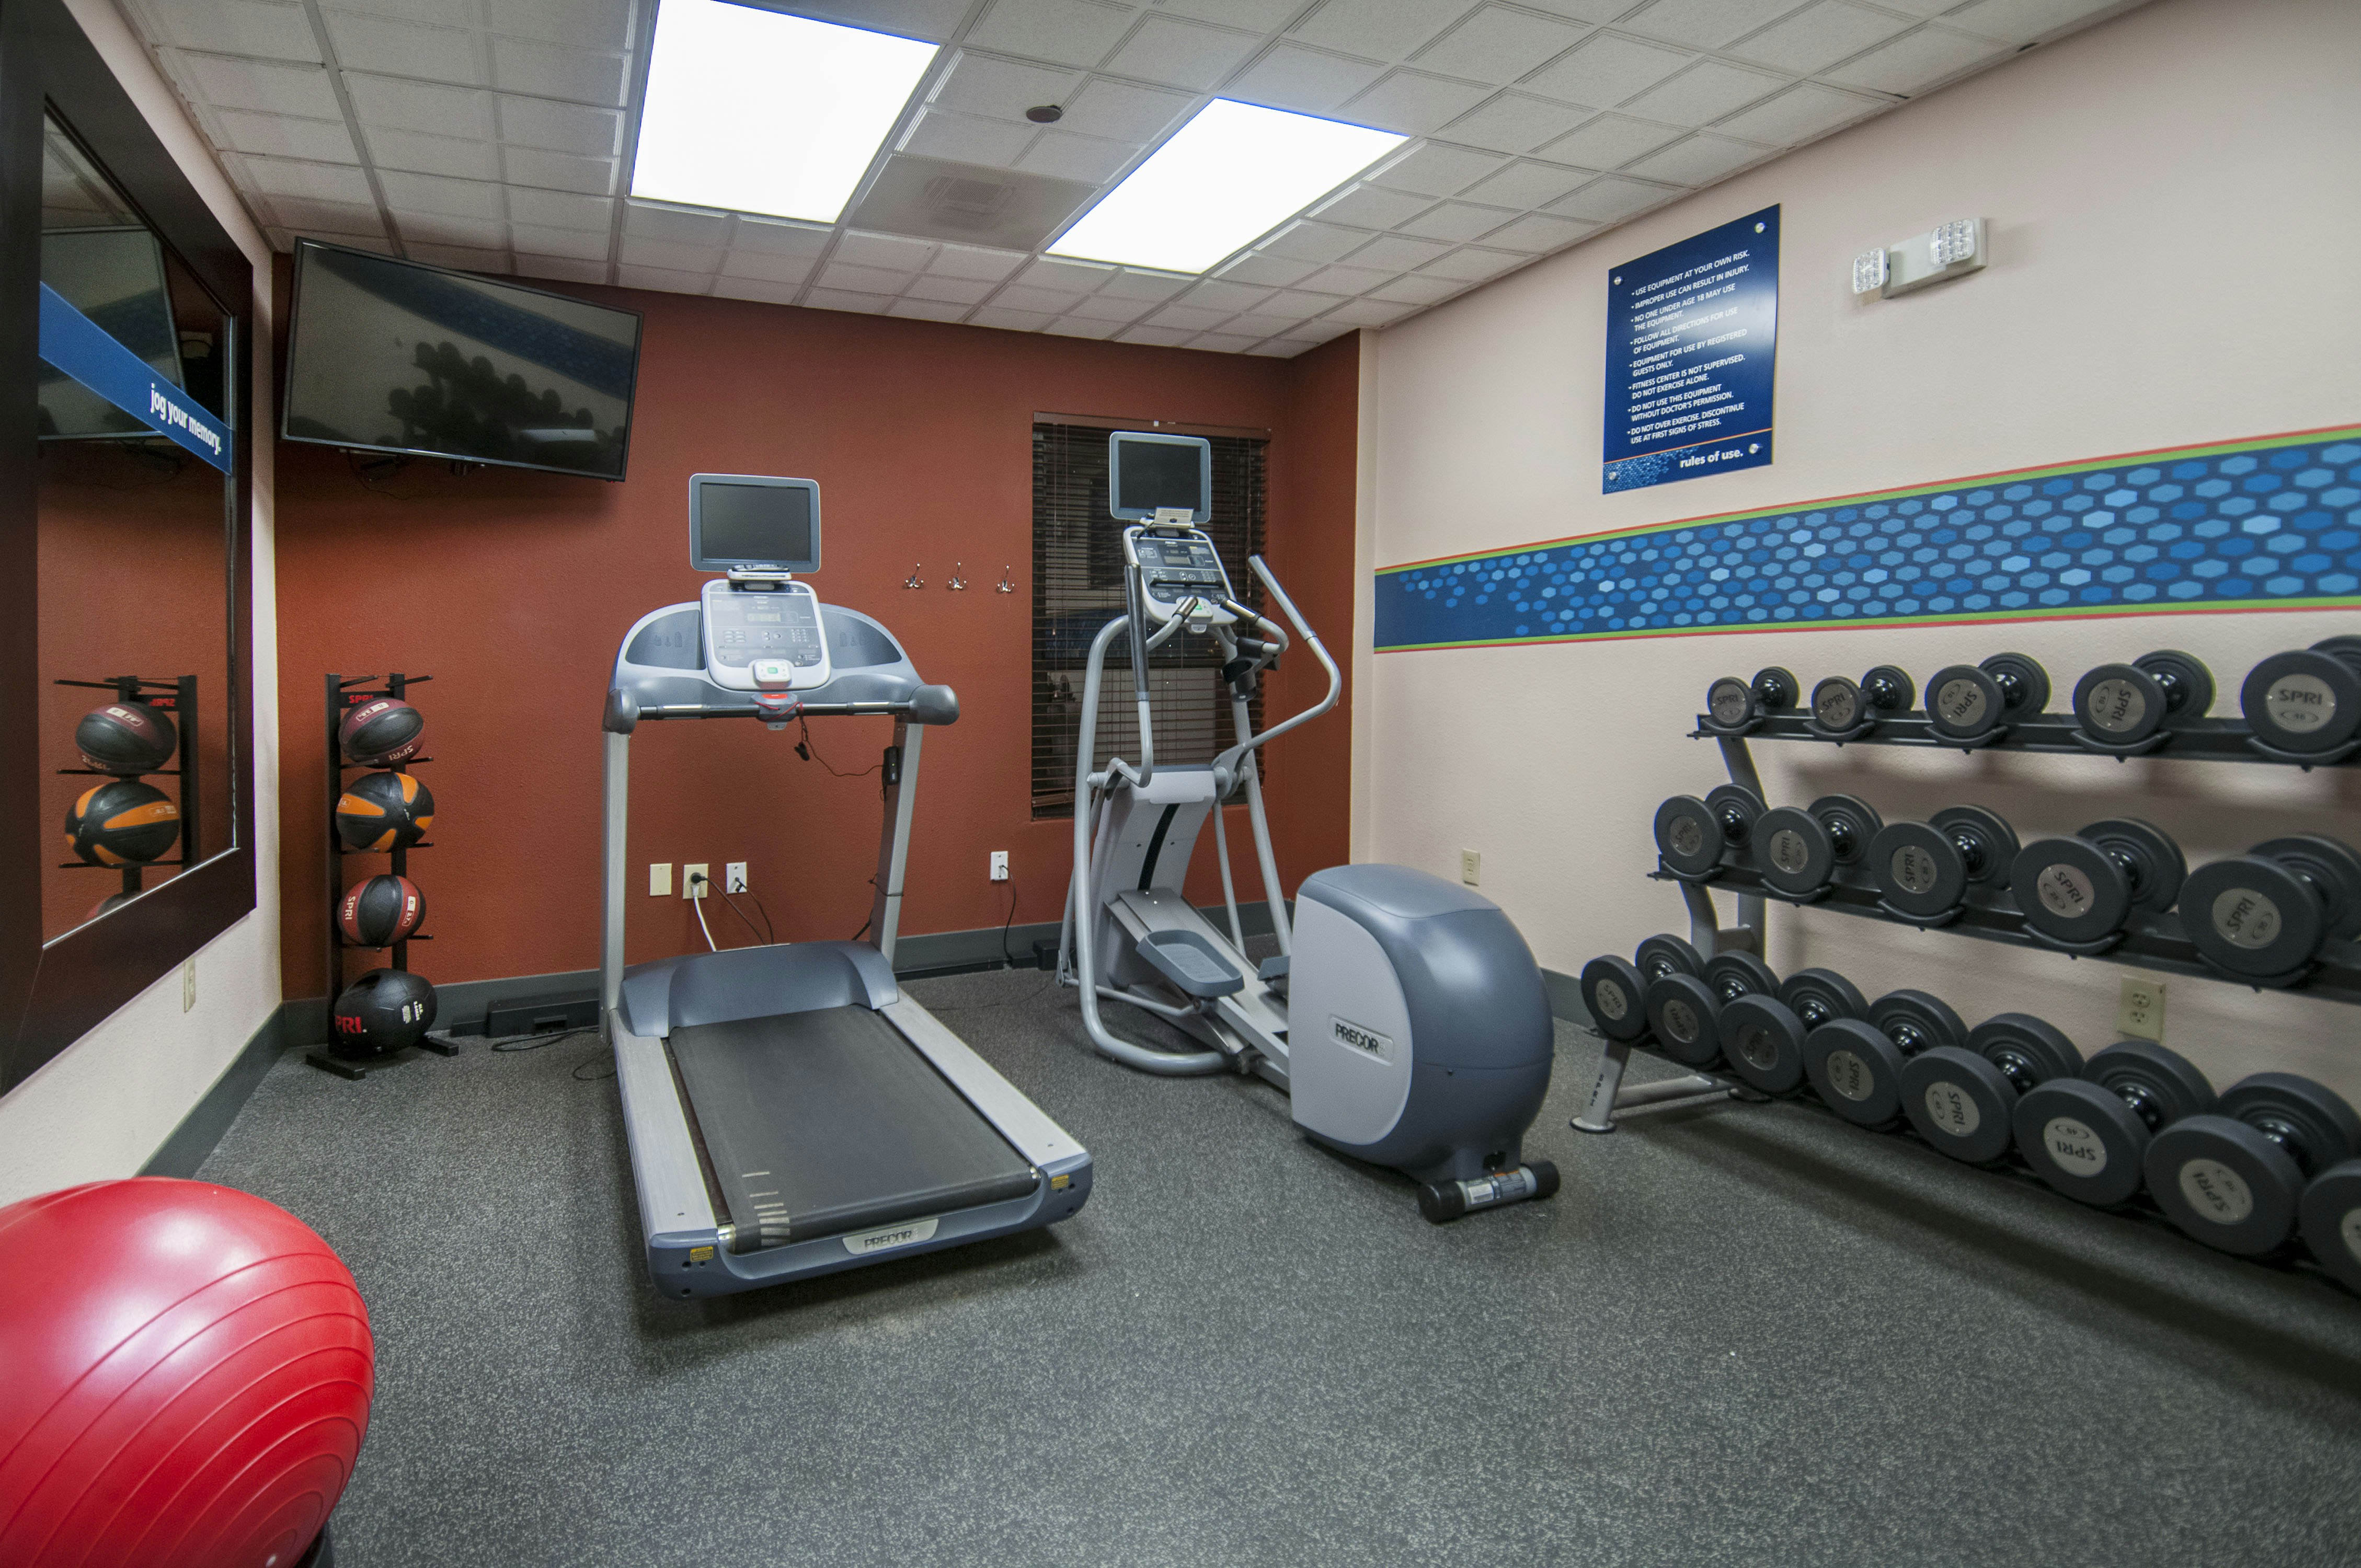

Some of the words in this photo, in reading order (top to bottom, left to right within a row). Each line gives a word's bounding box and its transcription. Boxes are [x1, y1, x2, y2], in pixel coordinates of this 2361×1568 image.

[1635, 286, 1646, 295] USE
[1648, 274, 1682, 291] EQUIPMENT
[1684, 270, 1693, 278] AT
[1694, 263, 1712, 275] YOUR
[1714, 256, 1731, 268] OWN
[1733, 250, 1749, 261] RISK.
[1635, 294, 1664, 308] IMPROPER
[1666, 289, 1677, 298] USE
[1678, 284, 1691, 294] CAN
[1693, 276, 1715, 289] RESULT
[1725, 264, 1749, 278] INJURY.
[1645, 309, 1658, 318] ONE
[1659, 302, 1680, 314] UNDER
[1682, 297, 1694, 306] AGE
[1706, 288, 1721, 298] MAY
[1723, 283, 1735, 293] USE
[1634, 322, 1645, 331] THE
[1647, 310, 1683, 327] EQUIPMENT.
[1634, 331, 1659, 344] FOLLOW
[1660, 328, 1671, 337] ALL
[1673, 316, 1709, 332] DIRECTIONS
[1711, 312, 1723, 321] FOR
[1726, 307, 1738, 316] USE
[1633, 352, 1668, 367] EQUIPMENT
[1670, 348, 1682, 356] FOR
[1684, 344, 1695, 353] USE
[1707, 329, 1747, 346] REGISTERED
[1643, 335, 1679, 351] EQUIPMENT.
[1632, 378, 1655, 389] FITNESS
[1657, 371, 1679, 383] CENTER
[1689, 365, 1702, 375] NOT
[1704, 353, 1745, 371] SUPERVISED.
[1633, 365, 1654, 376] GUESTS
[1656, 360, 1673, 370] ONLY.
[1643, 387, 1655, 396] NOT
[1657, 379, 1684, 393] EXERCISE
[1686, 373, 1709, 385] ALONE.
[1643, 401, 1655, 409] NOT
[1657, 398, 1667, 406] USE
[1669, 394, 1682, 403] THIS
[1684, 384, 1722, 399] EQUIPMENT
[150, 383, 167, 421] jog
[168, 401, 188, 429] your
[189, 416, 222, 455] memory.
[1632, 409, 1659, 421] WITHOUT
[1661, 401, 1692, 414] DOCTOR'S
[1693, 391, 1733, 406] PERMISSION.
[1642, 424, 1654, 432] NOT
[1655, 420, 1671, 429] OVER
[1702, 402, 1744, 418] DISCONTINUE
[1652, 430, 1667, 439] FIRST
[1669, 426, 1686, 435] SIGNS
[1698, 418, 1721, 429] STRESS.
[1680, 454, 1705, 468] rules
[1707, 451, 1719, 463] of
[1722, 448, 1743, 460] use.
[1717, 694, 1738, 705] SPRI
[1823, 693, 1846, 710] SPRI
[1953, 690, 1977, 717] SPRI
[2112, 690, 2131, 721] SPRI
[2279, 689, 2323, 706] SPRI
[388, 745, 414, 760] SPRI
[1675, 823, 1693, 843] SPRI
[1781, 837, 1790, 862] SPRI
[1905, 854, 1915, 883] SPRI
[2054, 872, 2084, 903] SPRI
[345, 896, 356, 920] SPRI
[2227, 897, 2255, 932] SPRI
[1604, 985, 1622, 1009] SPRI
[1336, 1023, 1379, 1054] PRECOR
[1849, 1060, 1860, 1091] SPRI
[1947, 1091, 1965, 1125] SPRI
[2057, 1141, 2096, 1161] SPRI
[2193, 1172, 2230, 1212] SPRI
[864, 1230, 912, 1248] PRECOR
